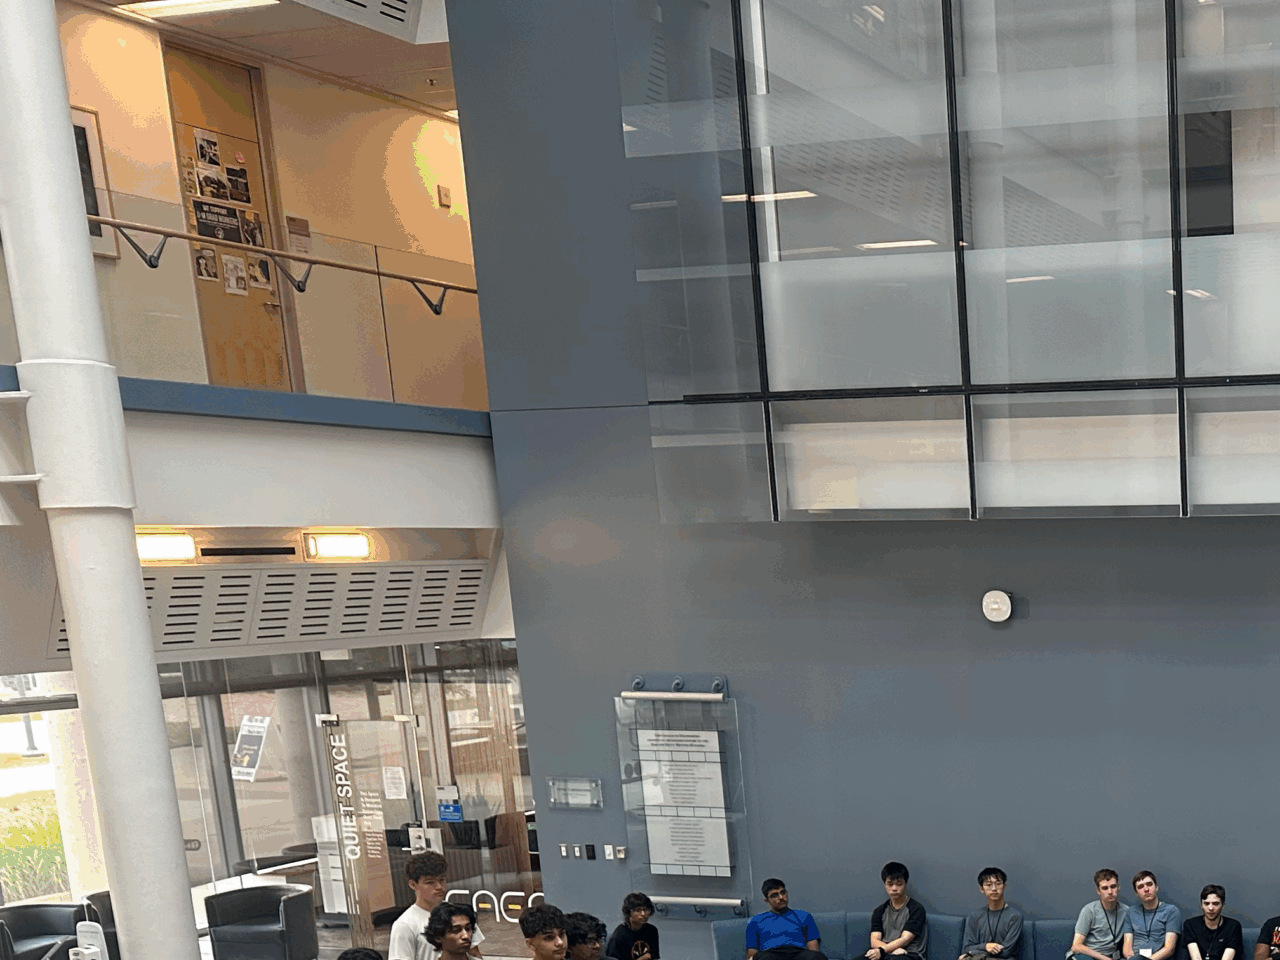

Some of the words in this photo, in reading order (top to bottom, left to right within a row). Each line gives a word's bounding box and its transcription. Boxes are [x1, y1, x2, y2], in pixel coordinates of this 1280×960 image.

[330, 734, 352, 798] SPACE
[339, 803, 361, 860] QUIET
[443, 889, 545, 923] AE
